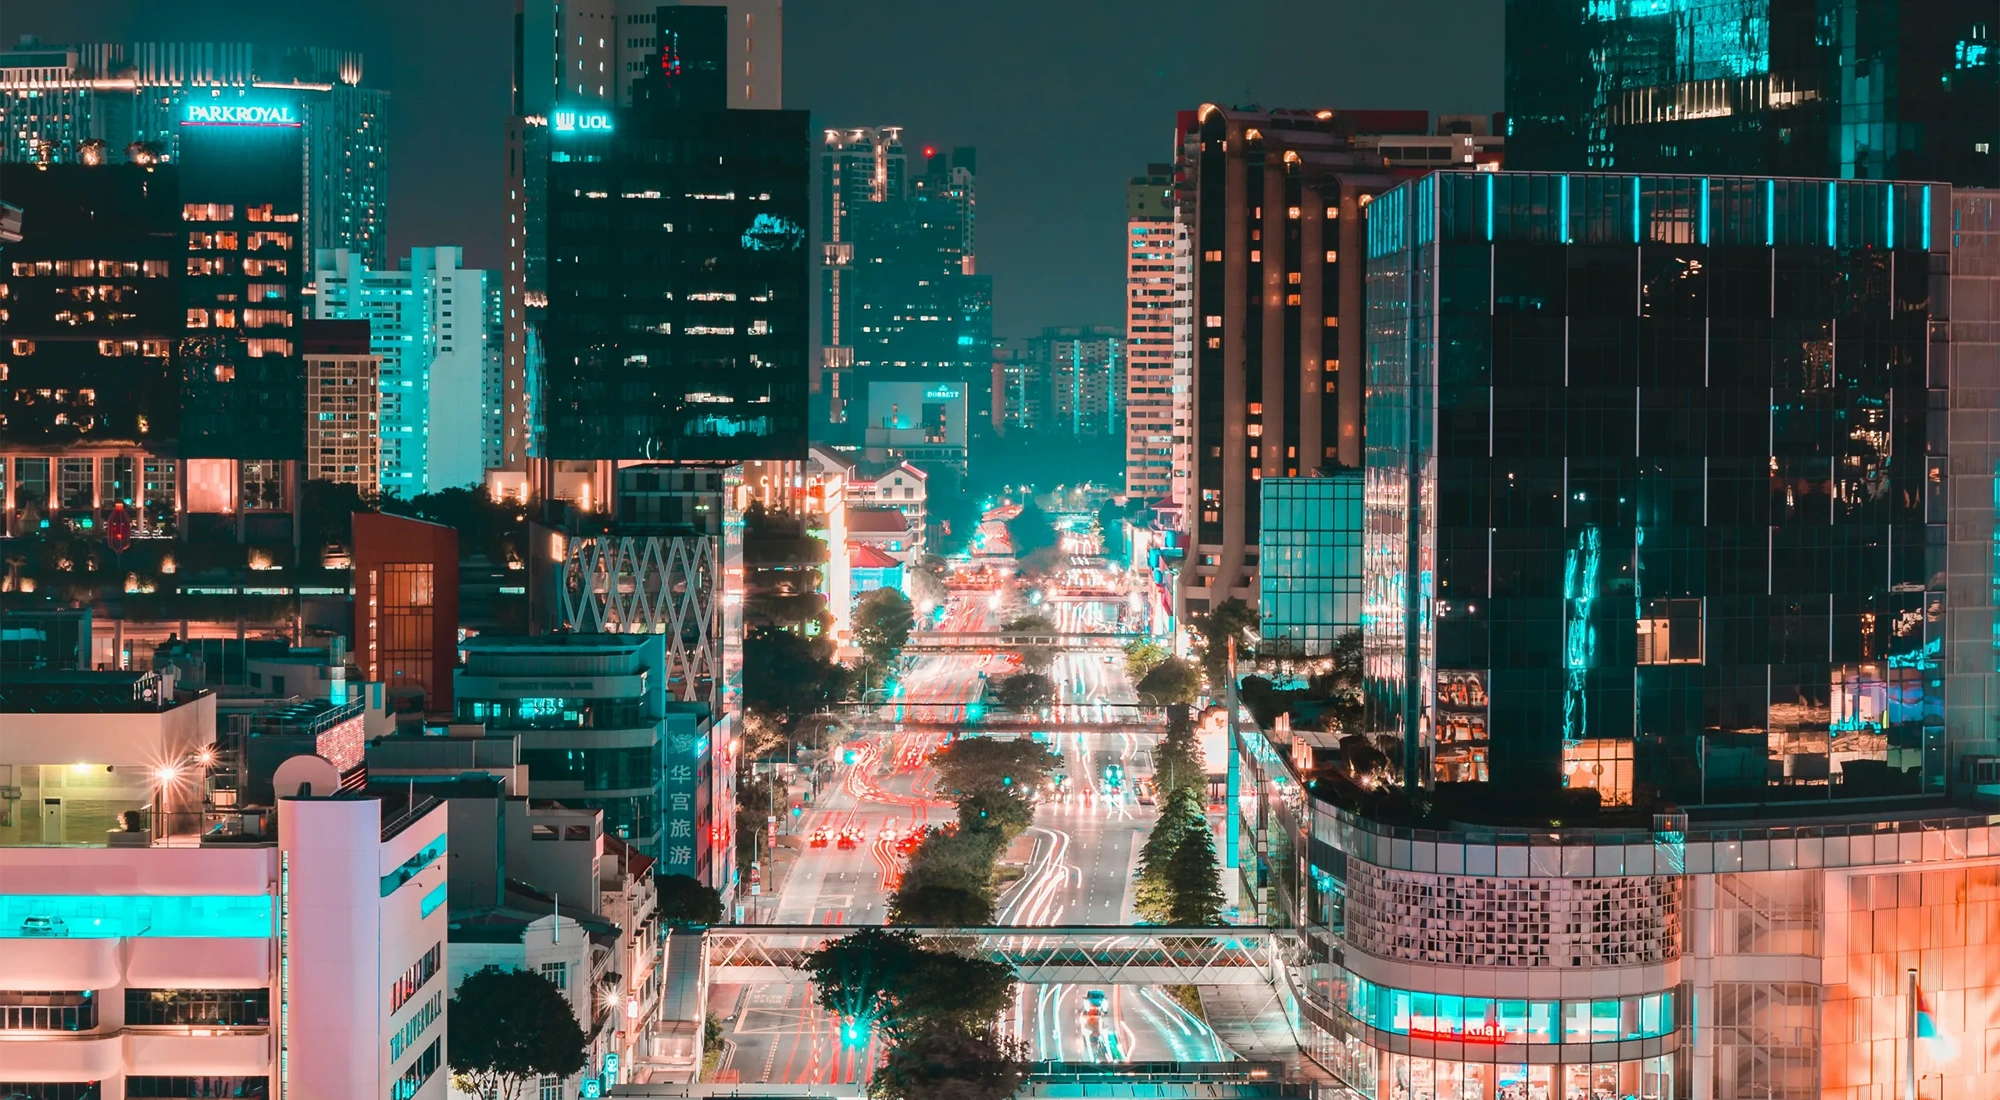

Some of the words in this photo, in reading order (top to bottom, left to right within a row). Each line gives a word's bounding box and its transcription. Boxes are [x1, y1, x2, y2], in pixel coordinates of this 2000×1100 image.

[188, 105, 294, 122] PARKROYAL
[579, 115, 612, 129] UOL
[670, 764, 692, 866] 华宫旅游
[390, 1027, 405, 1065] THE
[406, 989, 442, 1050] RIVERWALK
